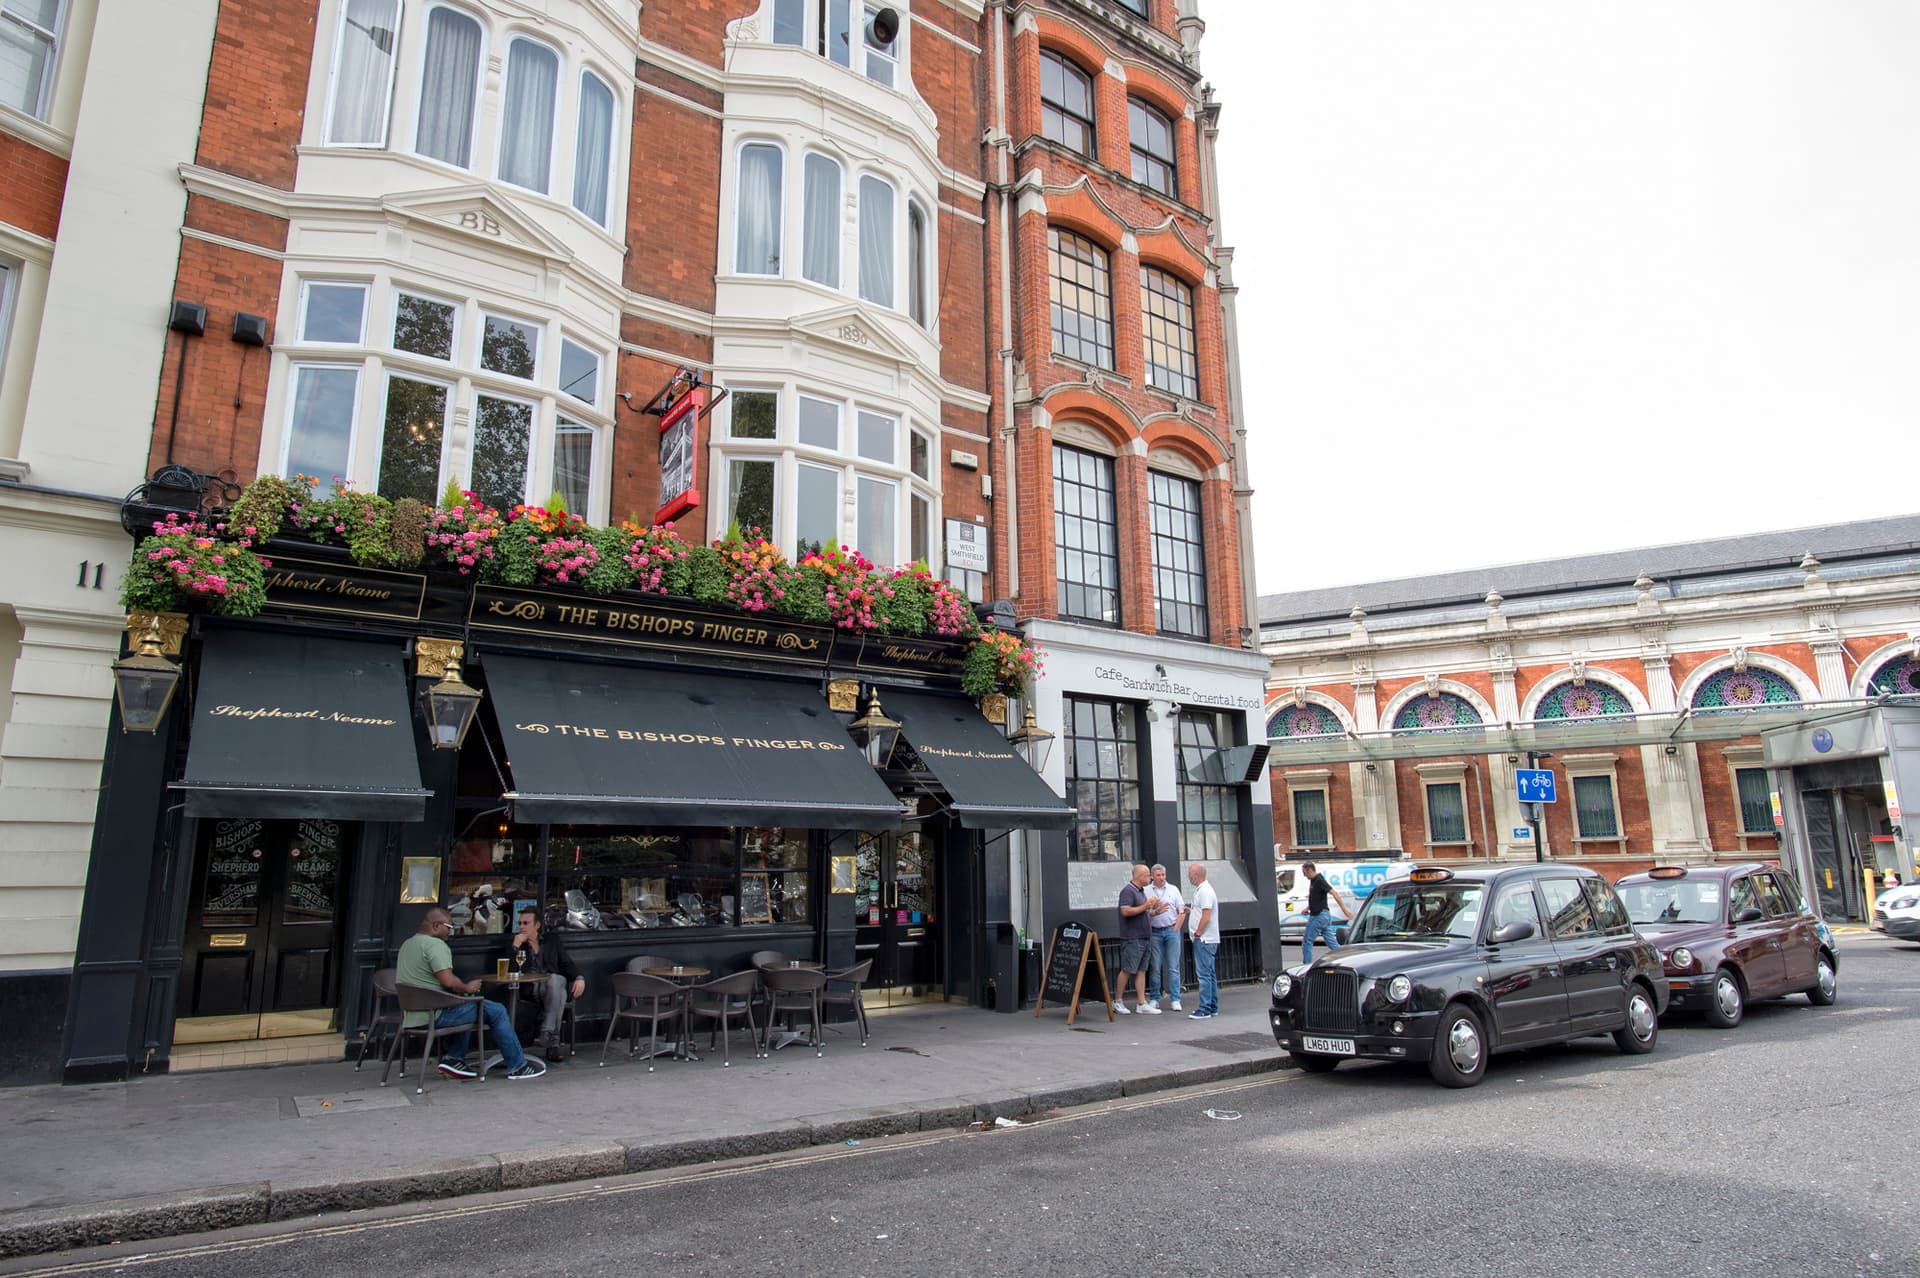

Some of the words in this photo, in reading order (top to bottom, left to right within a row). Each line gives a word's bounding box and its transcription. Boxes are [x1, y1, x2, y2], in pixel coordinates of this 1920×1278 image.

[950, 549, 985, 561] SMITHFIELD
[959, 543, 976, 552] WEST
[76, 559, 105, 590] 11
[264, 572, 327, 592] epherd
[326, 578, 392, 600] Neame
[557, 604, 599, 626] THE
[606, 611, 696, 636] BISHOPS
[701, 623, 769, 645] FINGER
[881, 644, 934, 662] Shepherd
[1094, 667, 1123, 681] Cafe
[1122, 677, 1173, 694] Sandwich
[1173, 682, 1192, 696] Bar
[1192, 691, 1235, 706] Oriental
[1237, 697, 1261, 709] food
[209, 704, 320, 721] Shepherd
[319, 711, 397, 726] Neame
[554, 724, 609, 739] THE
[616, 729, 726, 746] BISHOPS
[732, 737, 817, 750] FINGER
[919, 745, 974, 758] Shepherd
[974, 750, 1014, 759] Neame
[298, 822, 336, 848] FINGER
[211, 862, 260, 873] SHEPHERD
[296, 861, 331, 873] NEAME
